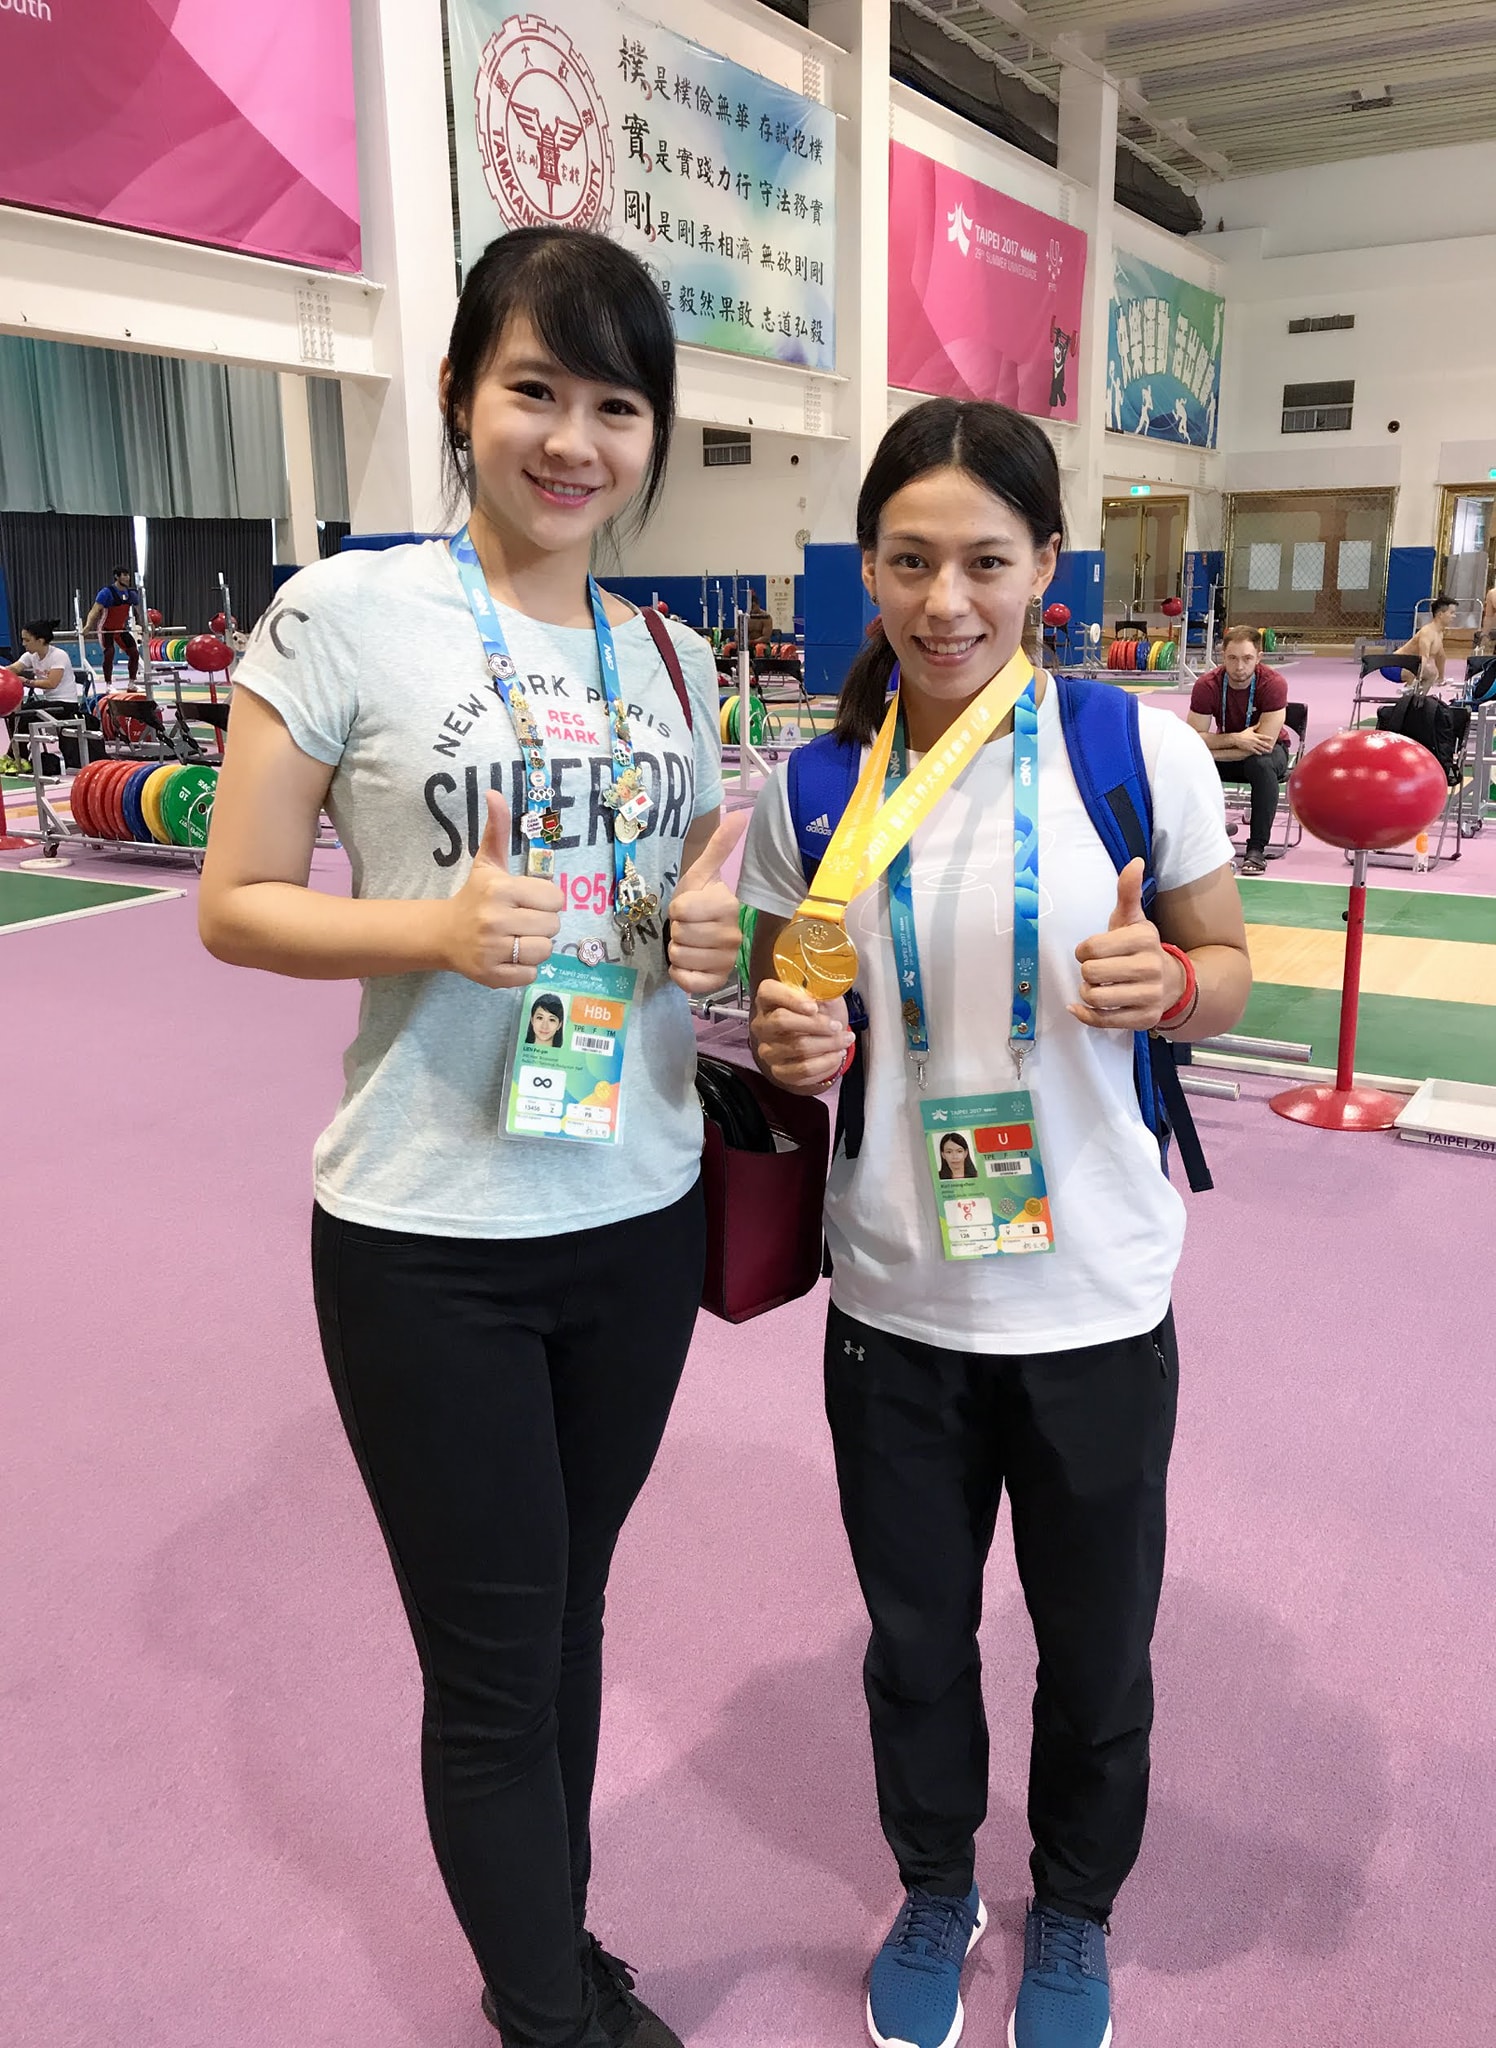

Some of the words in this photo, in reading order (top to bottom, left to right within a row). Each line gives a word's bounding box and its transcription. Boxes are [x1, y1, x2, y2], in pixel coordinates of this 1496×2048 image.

[759, 180, 824, 226] 守法務實
[975, 224, 1000, 250] TAIPEI
[1002, 236, 1019, 257] 2017
[759, 243, 824, 286] 無欲則剛
[986, 251, 1008, 269] SUMMER
[761, 306, 825, 345] 志道弘毅
[432, 692, 489, 758] NEW
[586, 686, 672, 738] PRIS
[547, 709, 585, 727] REG
[545, 725, 600, 746] MARK
[1019, 756, 1032, 787] NXP
[806, 825, 832, 836] adidas
[862, 831, 890, 865] 2017
[583, 1004, 612, 1021] HBb
[573, 1025, 585, 1033] TPE
[606, 1030, 617, 1038] TM
[998, 1132, 1009, 1145] U
[1426, 1132, 1469, 1149] TAIPEI
